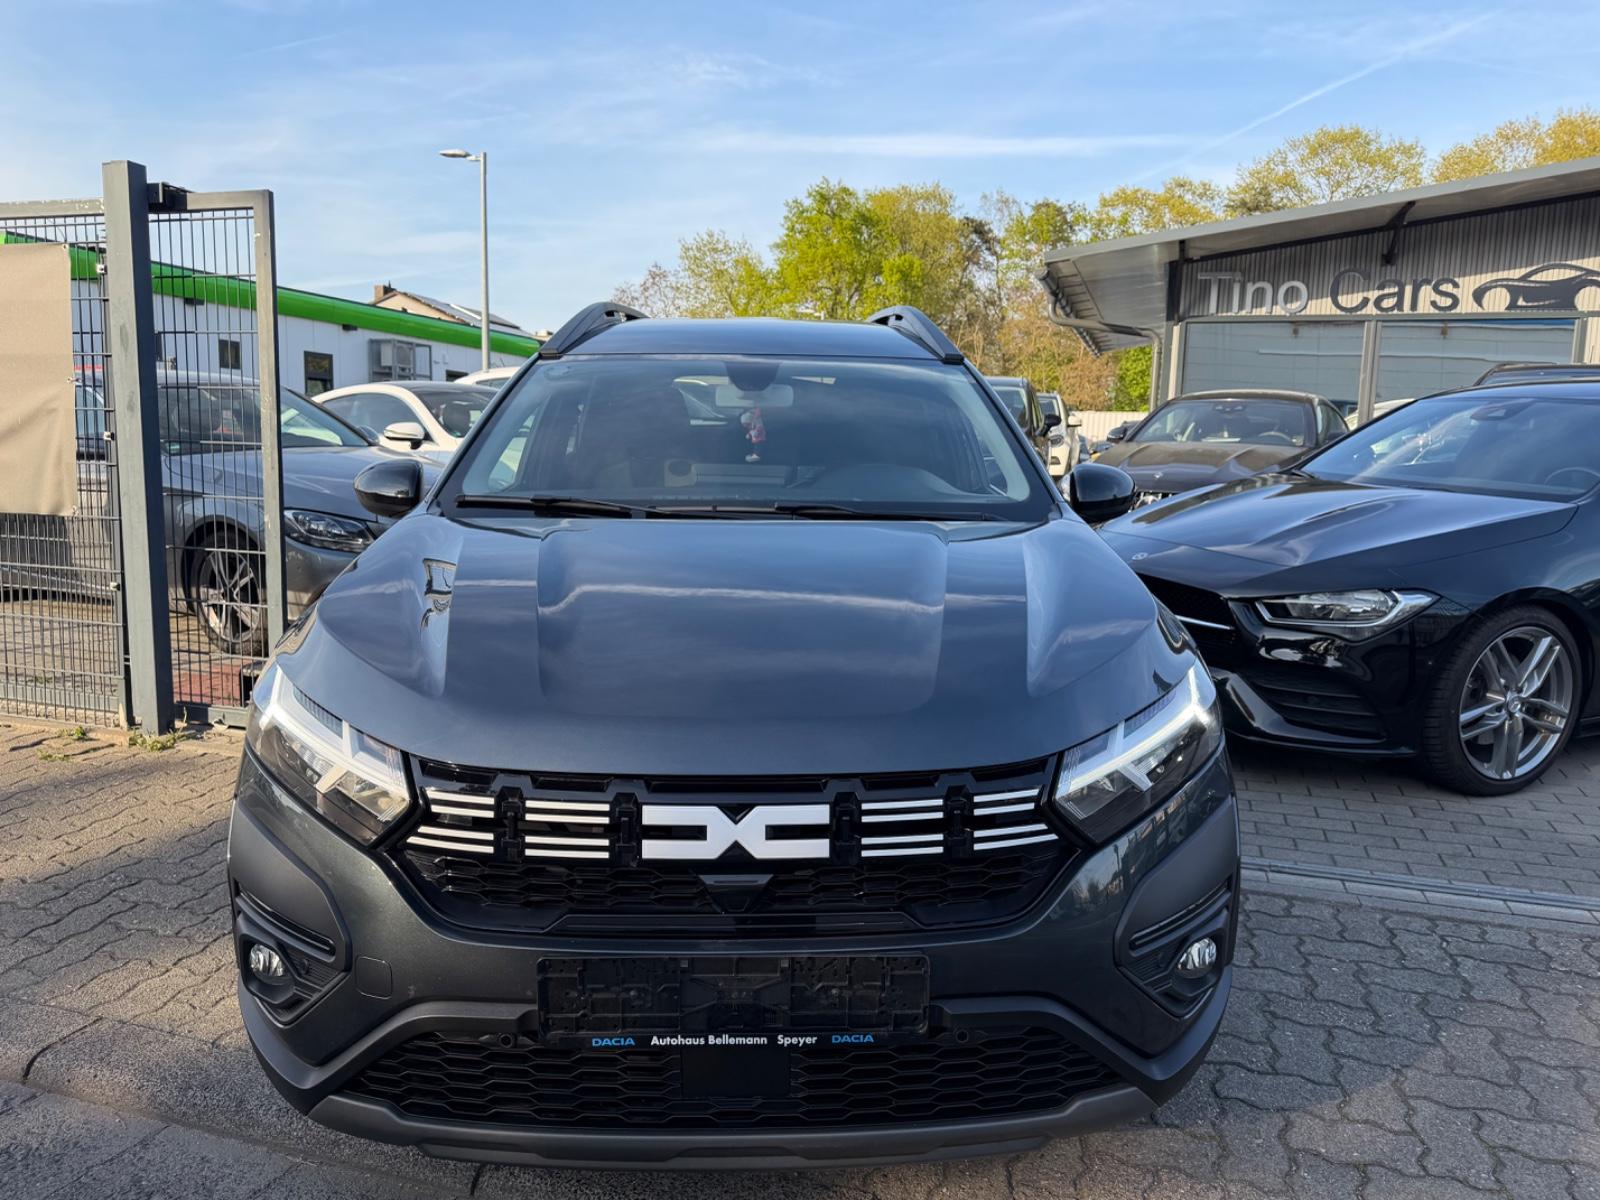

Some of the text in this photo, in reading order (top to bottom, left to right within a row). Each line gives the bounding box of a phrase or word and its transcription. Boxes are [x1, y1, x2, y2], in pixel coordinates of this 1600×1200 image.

[1197, 268, 1460, 315] Tino Cars
[591, 1033, 875, 1047] DACIA Autohaus Bellemann Speyer DACIA
